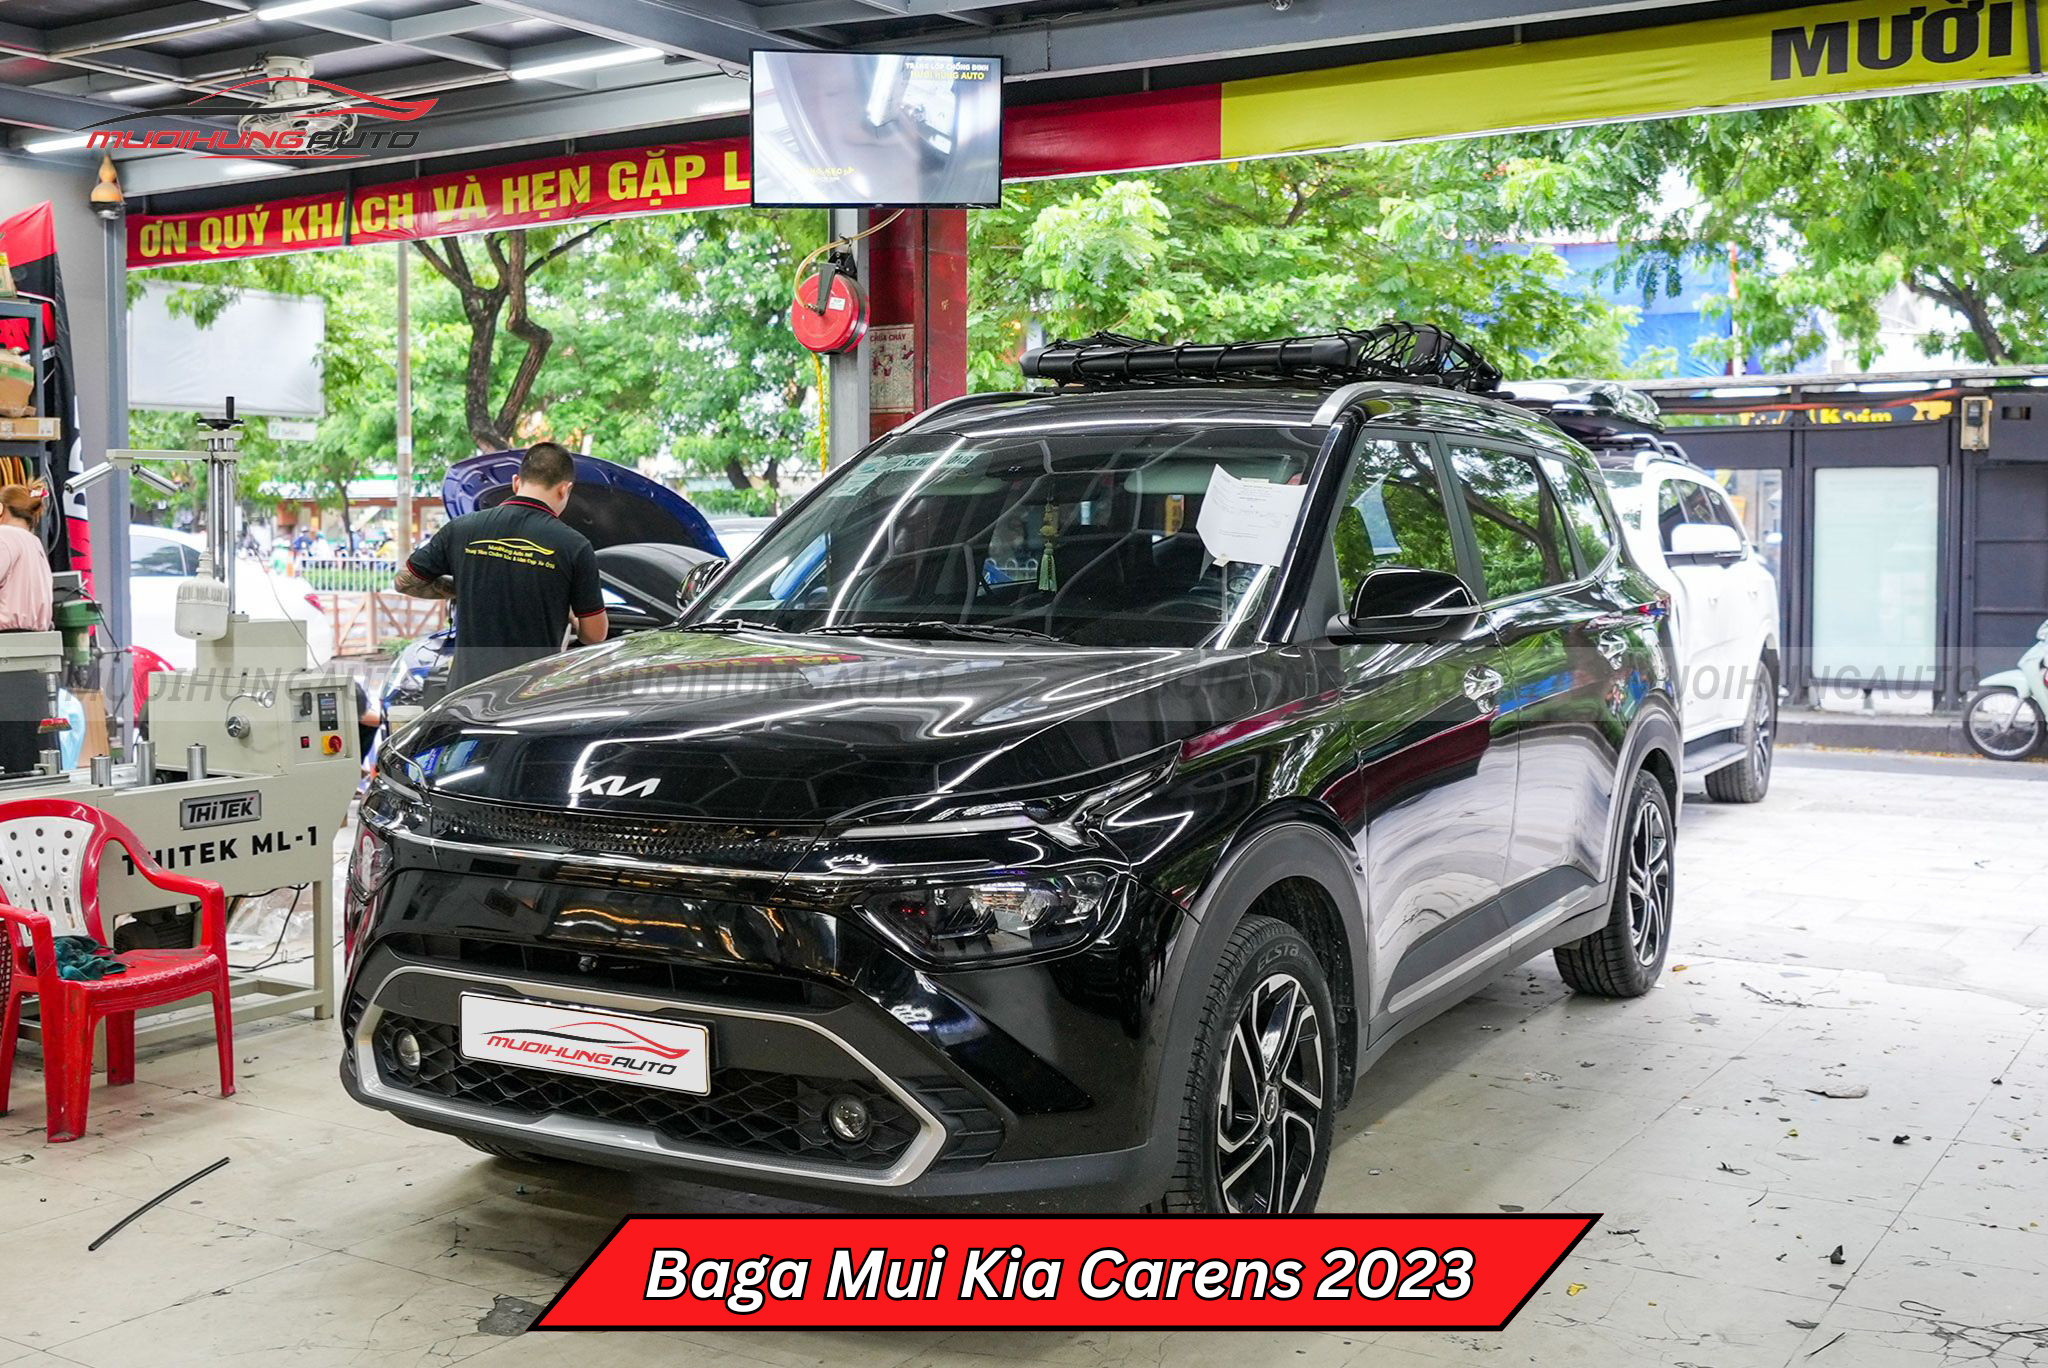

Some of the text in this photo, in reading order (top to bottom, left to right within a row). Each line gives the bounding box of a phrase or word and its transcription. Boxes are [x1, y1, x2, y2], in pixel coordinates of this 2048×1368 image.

[960, 72, 985, 80] AUTO
[1771, 0, 2013, 80] MƯỜI
[139, 219, 188, 258] ƠN
[200, 204, 269, 254] QUÝ
[432, 175, 489, 223] VÀ
[502, 165, 591, 219] HẸN
[608, 149, 706, 206] GẶP
